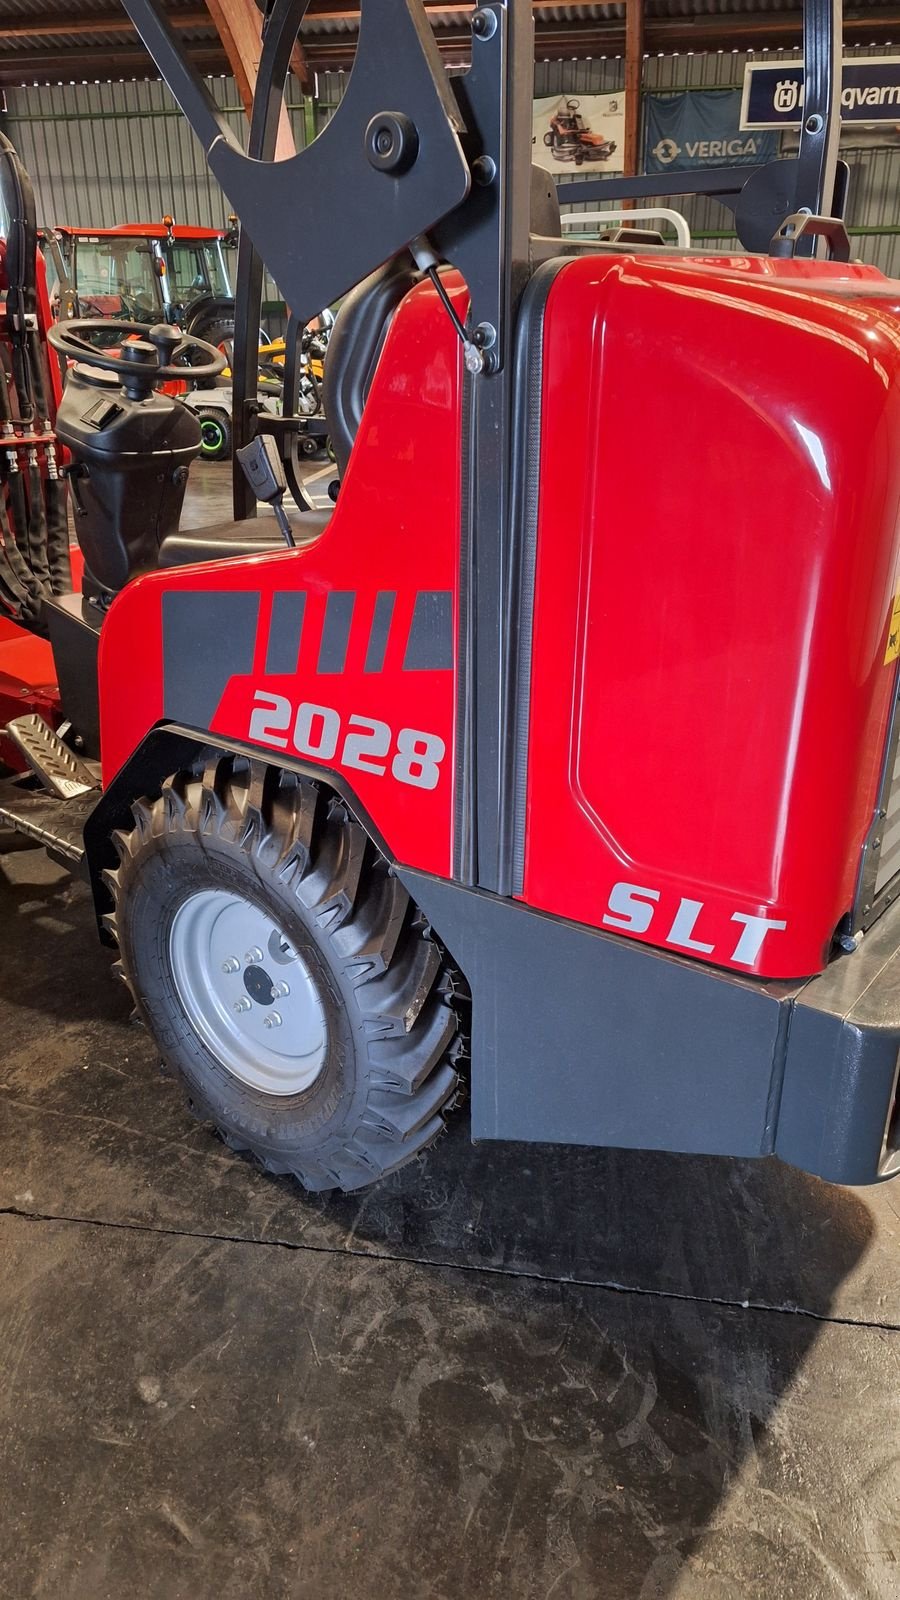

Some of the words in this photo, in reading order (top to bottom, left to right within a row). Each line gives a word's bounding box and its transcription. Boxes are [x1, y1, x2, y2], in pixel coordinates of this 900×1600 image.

[685, 138, 757, 158] VERIGA
[248, 690, 446, 790] 2028
[602, 882, 787, 966] SLT
